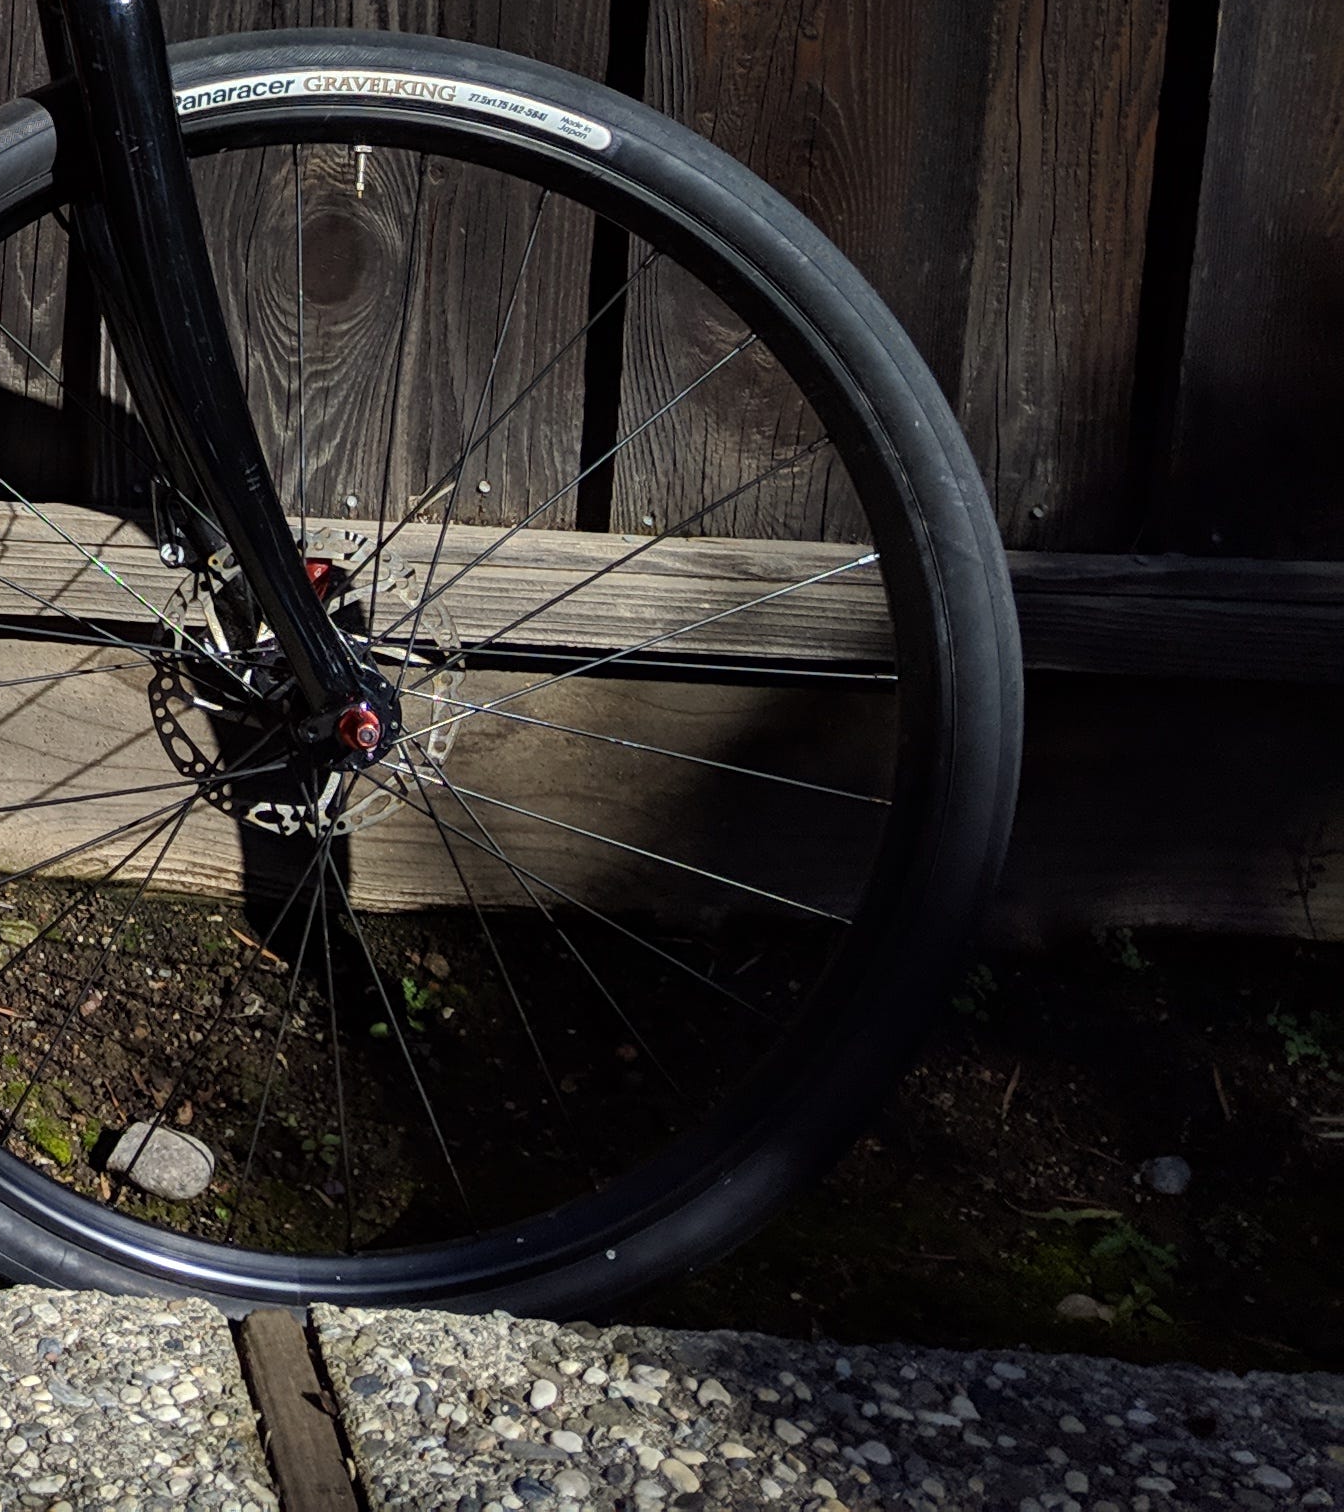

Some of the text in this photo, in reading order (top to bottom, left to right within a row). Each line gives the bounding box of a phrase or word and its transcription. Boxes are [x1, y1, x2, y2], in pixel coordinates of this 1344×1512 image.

[303, 75, 457, 102] GRAVELKING
[560, 116, 585, 130] Made
[557, 124, 588, 140] Japan
